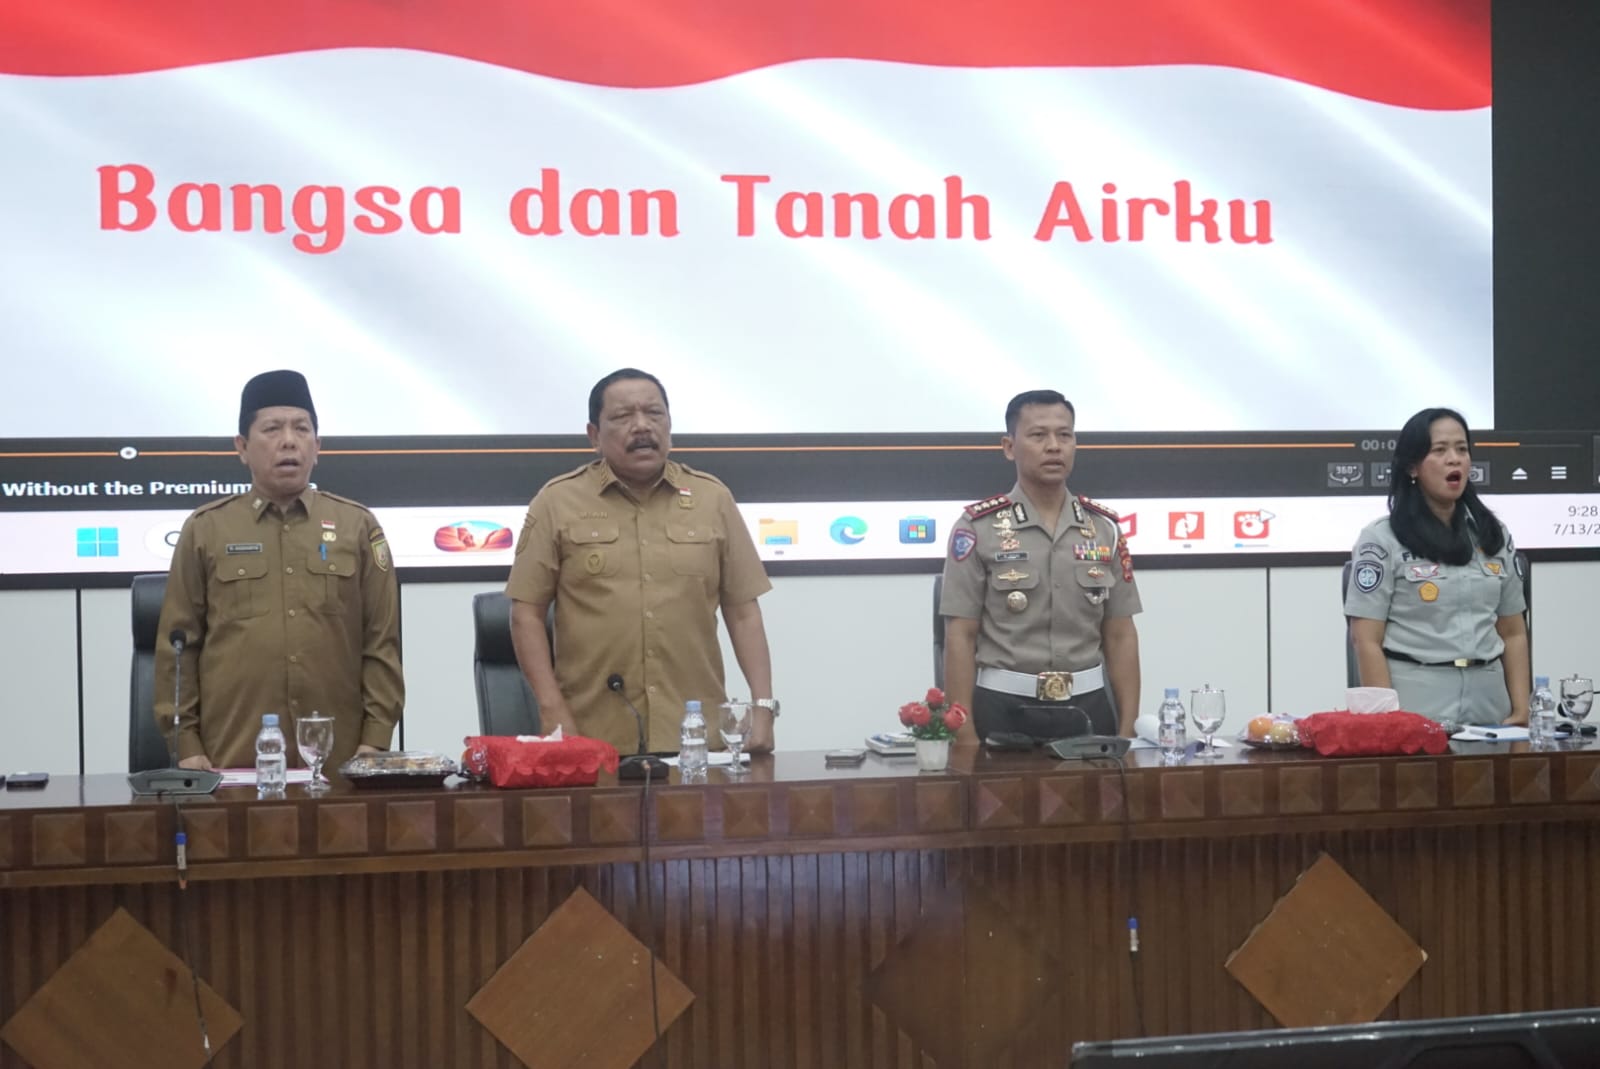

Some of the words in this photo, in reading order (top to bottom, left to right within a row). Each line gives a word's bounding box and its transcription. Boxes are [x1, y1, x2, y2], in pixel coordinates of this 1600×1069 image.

[97, 164, 461, 255] Bangsa
[510, 168, 680, 238] dan
[720, 174, 991, 241] Tanah
[1035, 179, 1274, 245] Airku
[2, 481, 99, 497] Without
[104, 480, 144, 496] the
[149, 480, 253, 495] Premium
[1567, 505, 1599, 518] 9:28
